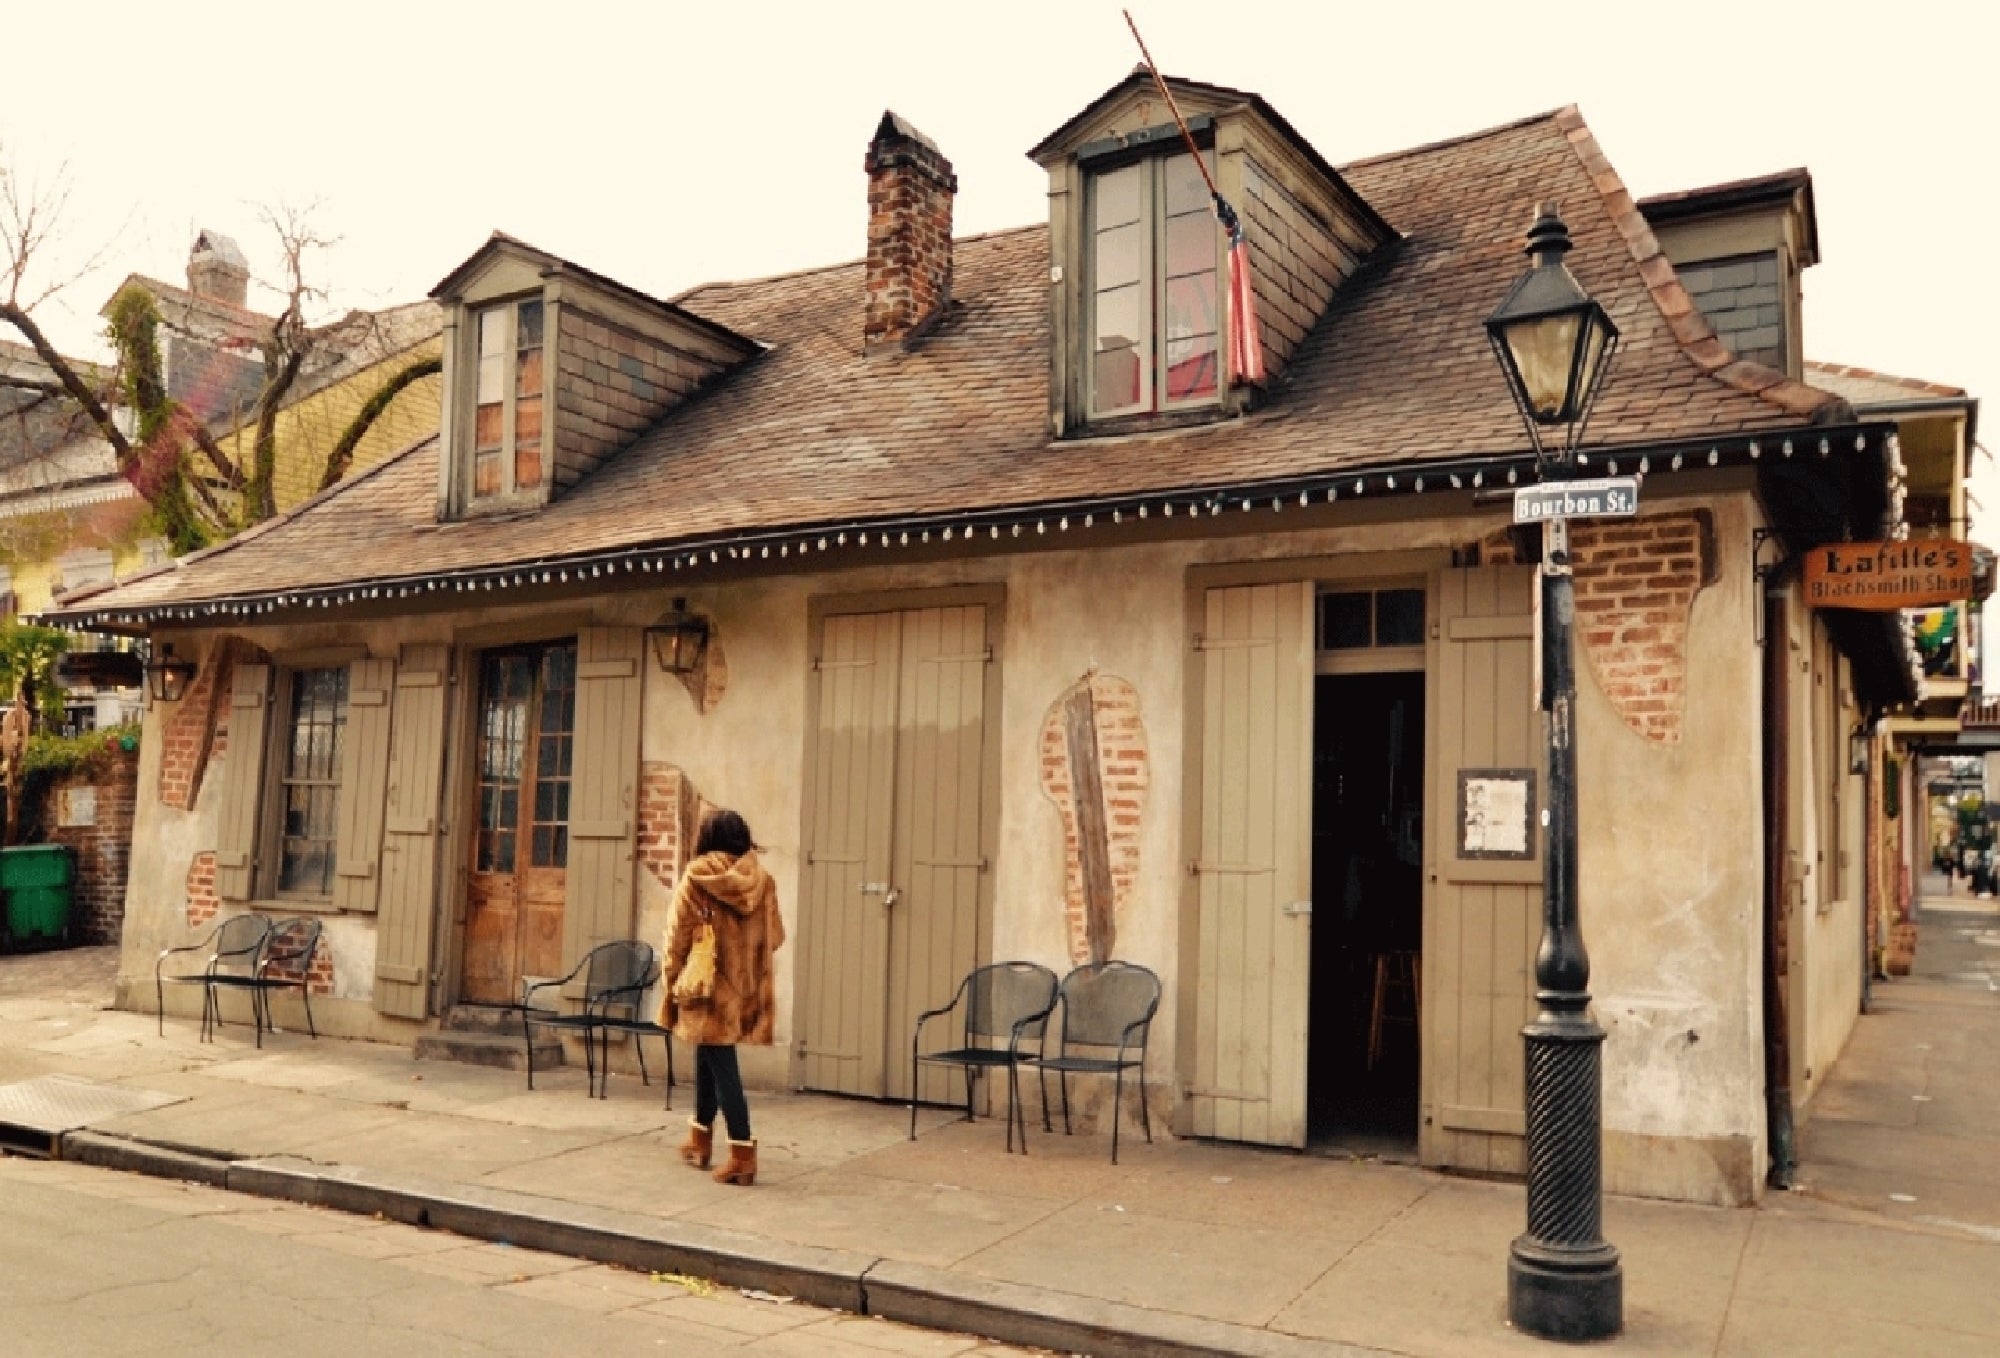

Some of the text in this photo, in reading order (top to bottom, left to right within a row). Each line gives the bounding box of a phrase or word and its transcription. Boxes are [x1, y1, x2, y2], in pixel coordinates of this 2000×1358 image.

[1517, 490, 1633, 518] Bourbon St.
[1811, 572, 1971, 598] Blacksmith Shop
